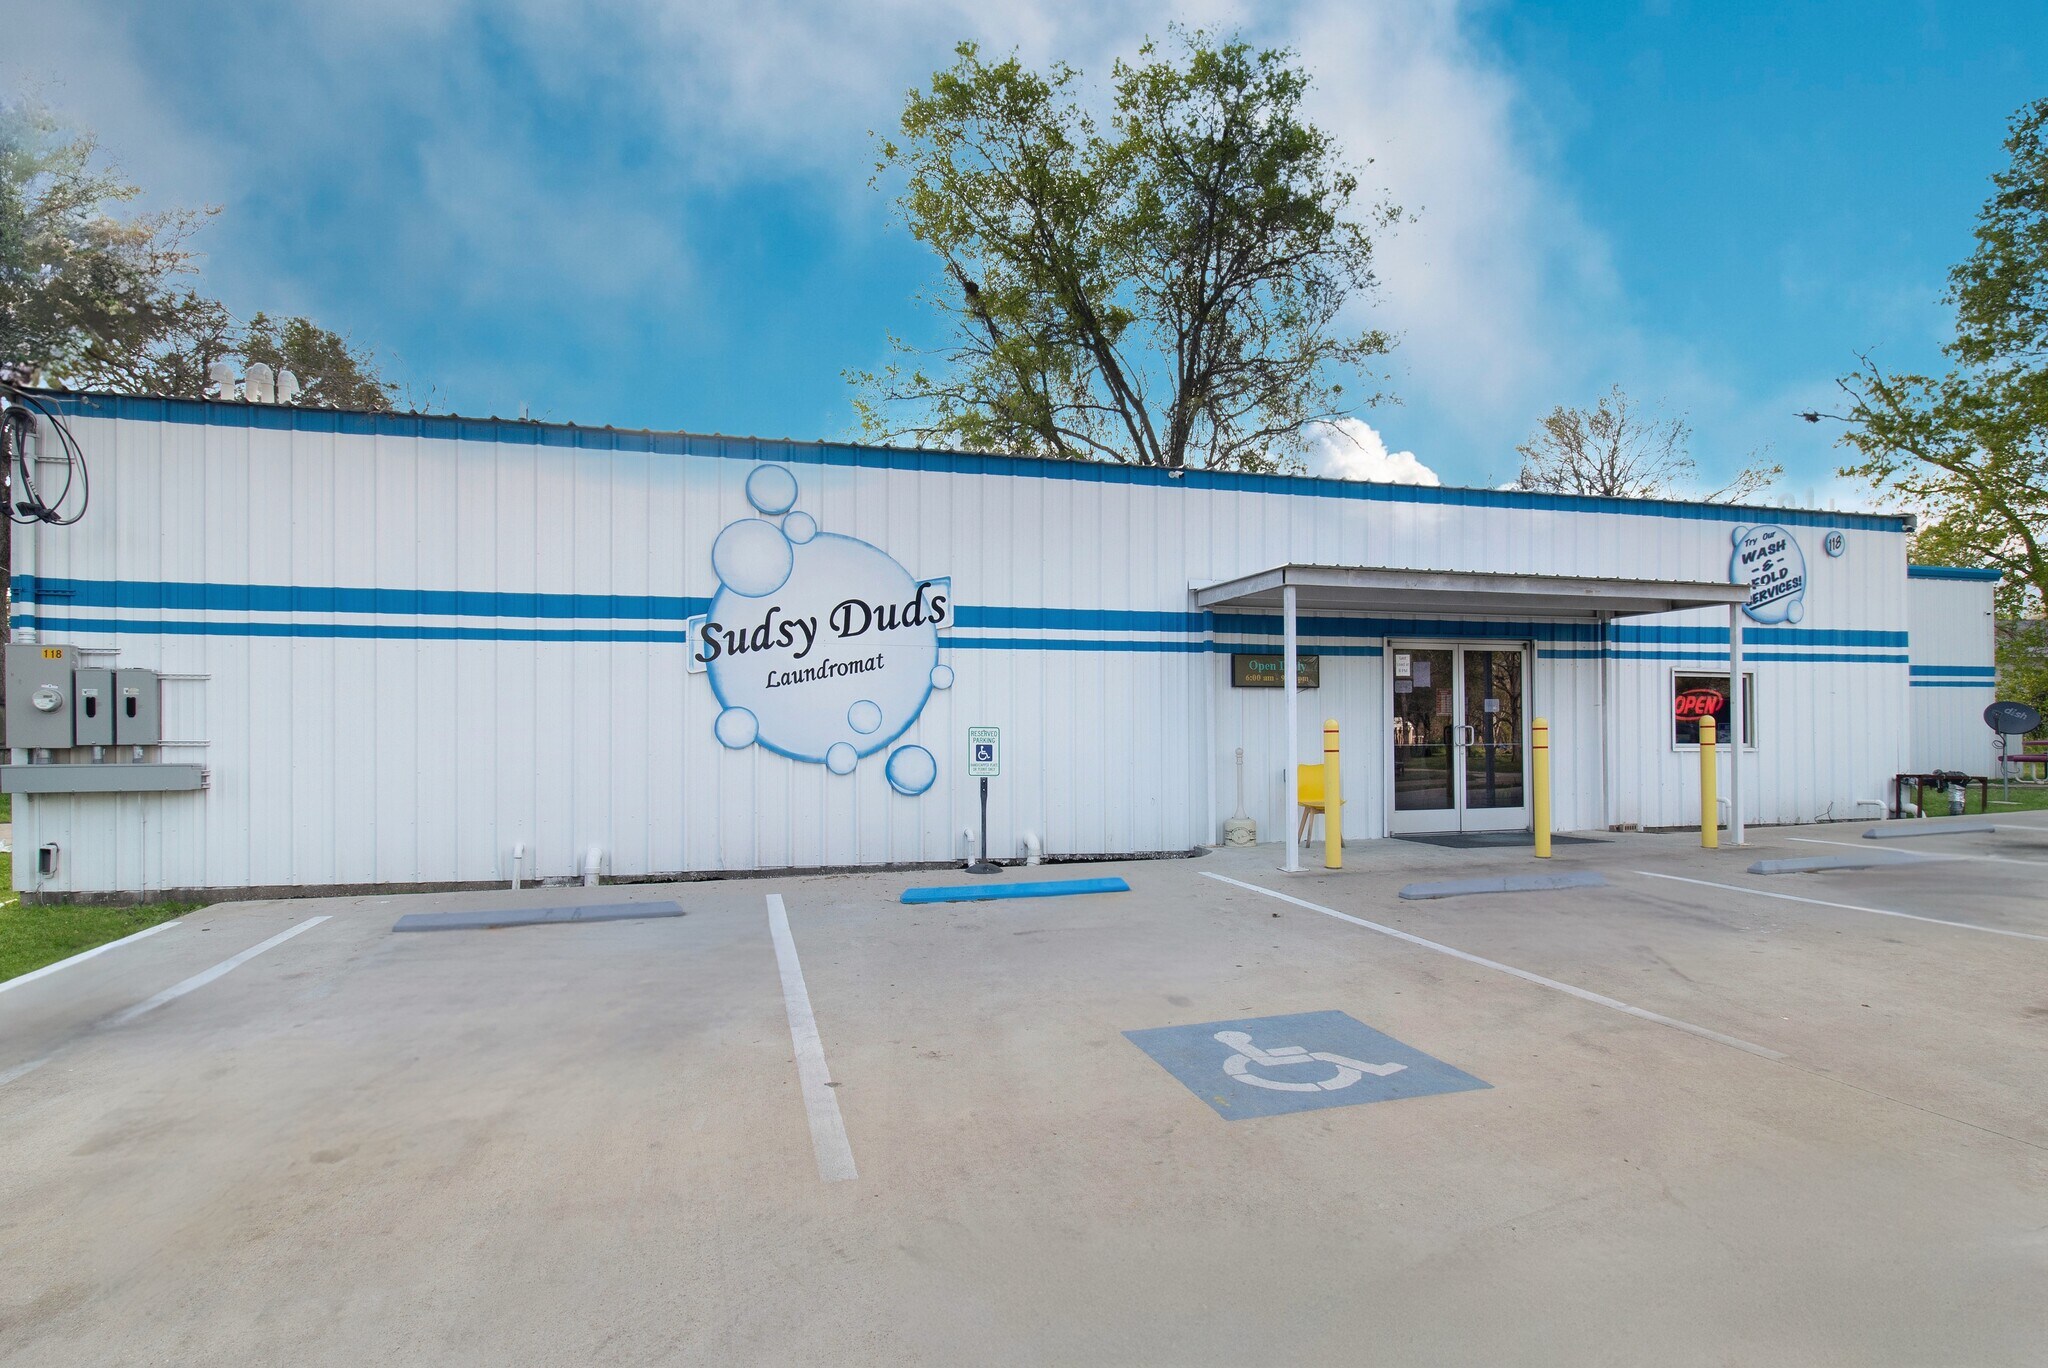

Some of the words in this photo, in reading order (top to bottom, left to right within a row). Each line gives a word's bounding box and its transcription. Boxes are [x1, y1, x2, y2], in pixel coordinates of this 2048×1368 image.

[1745, 538, 1758, 547] Try
[1762, 531, 1776, 540] Our
[1829, 535, 1841, 551] 118
[1741, 539, 1786, 565] WASH
[1762, 560, 1773, 572] &
[1751, 567, 1788, 590] FOLD
[695, 606, 817, 659] Sudsy
[829, 582, 947, 639] Duds
[43, 649, 62, 658] 118
[765, 653, 885, 689] Laundromat
[1248, 659, 1277, 673] Open
[1245, 674, 1261, 682] 6:00
[1298, 675, 1309, 684] pm
[1675, 695, 1717, 714] OPEN
[2004, 707, 2028, 720] dish
